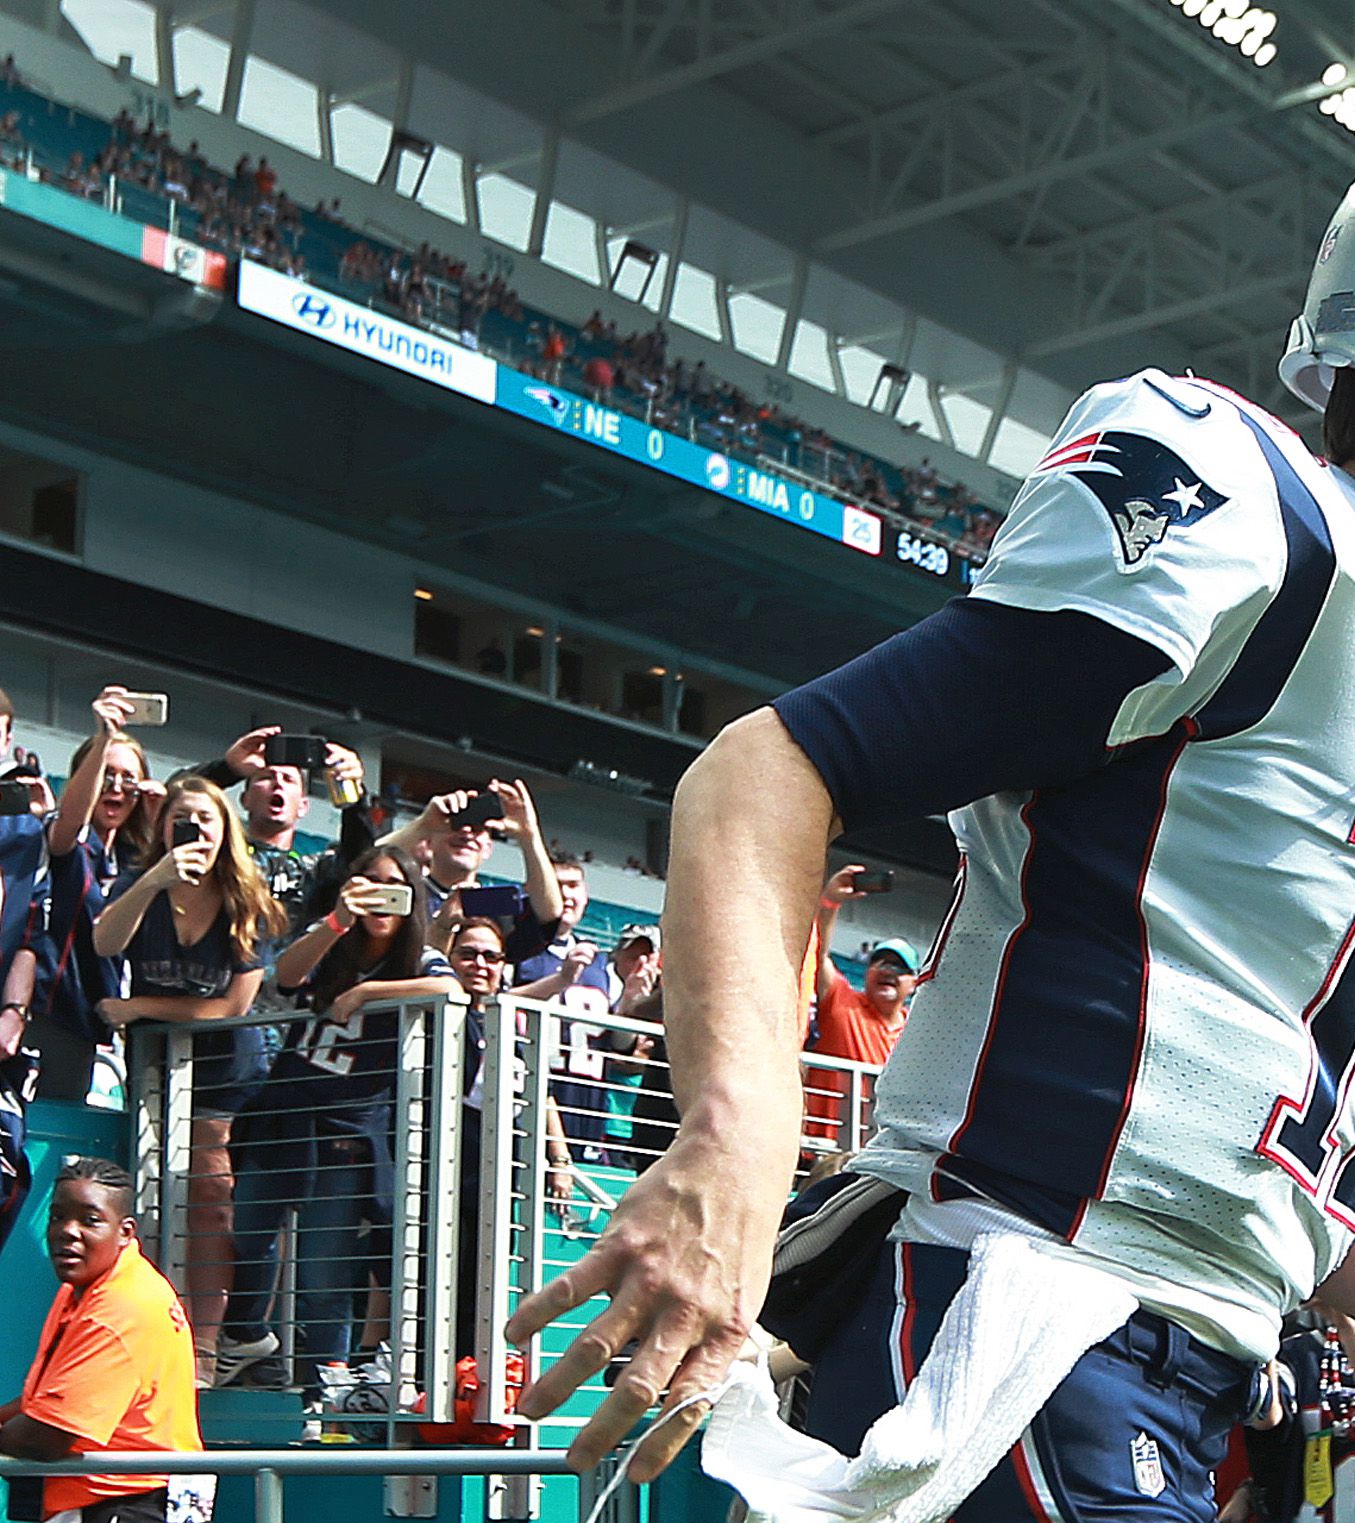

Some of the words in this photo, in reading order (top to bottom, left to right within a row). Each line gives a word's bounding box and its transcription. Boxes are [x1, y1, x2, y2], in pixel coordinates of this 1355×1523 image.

[343, 312, 453, 376] HYUNDAI
[583, 404, 622, 445] NE
[646, 428, 665, 461] 0
[748, 470, 790, 513] MIA
[799, 491, 815, 521] 0
